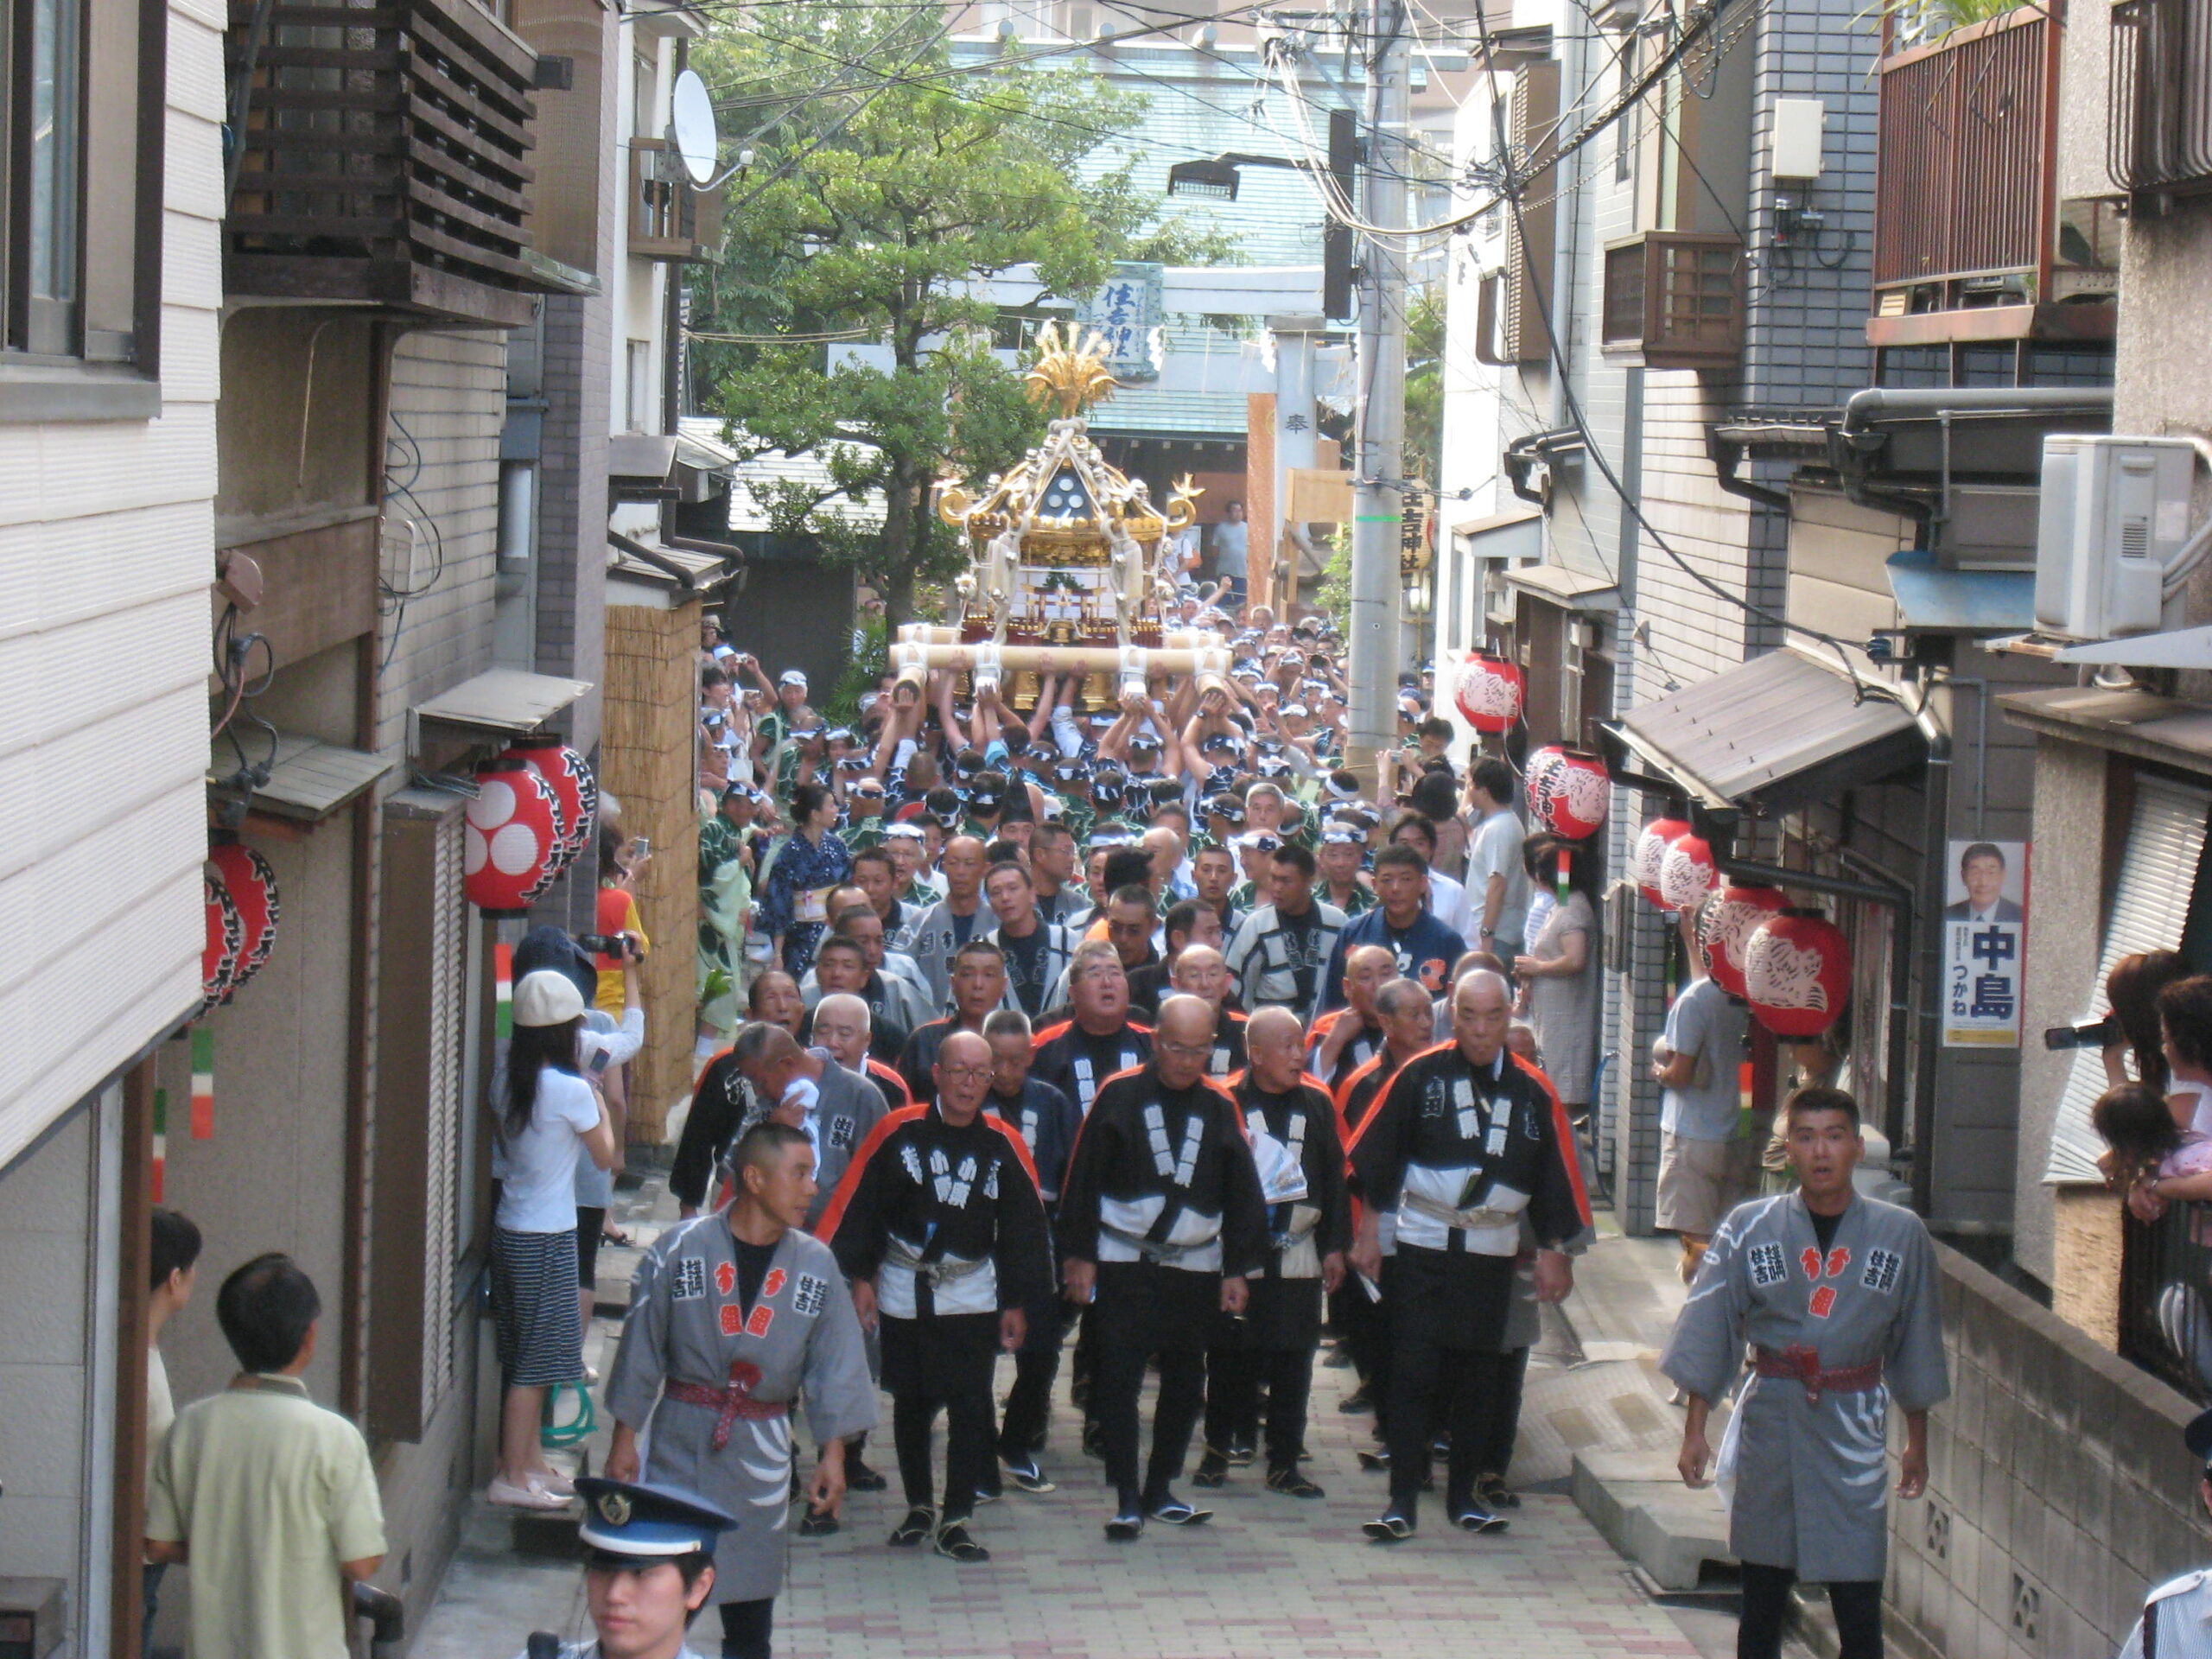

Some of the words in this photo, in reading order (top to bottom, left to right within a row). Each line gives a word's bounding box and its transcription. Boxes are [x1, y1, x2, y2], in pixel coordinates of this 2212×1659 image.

[1285, 414, 1309, 435] 奉
[1952, 965, 1967, 1016] つかね
[1971, 925, 2015, 1020] 中島
